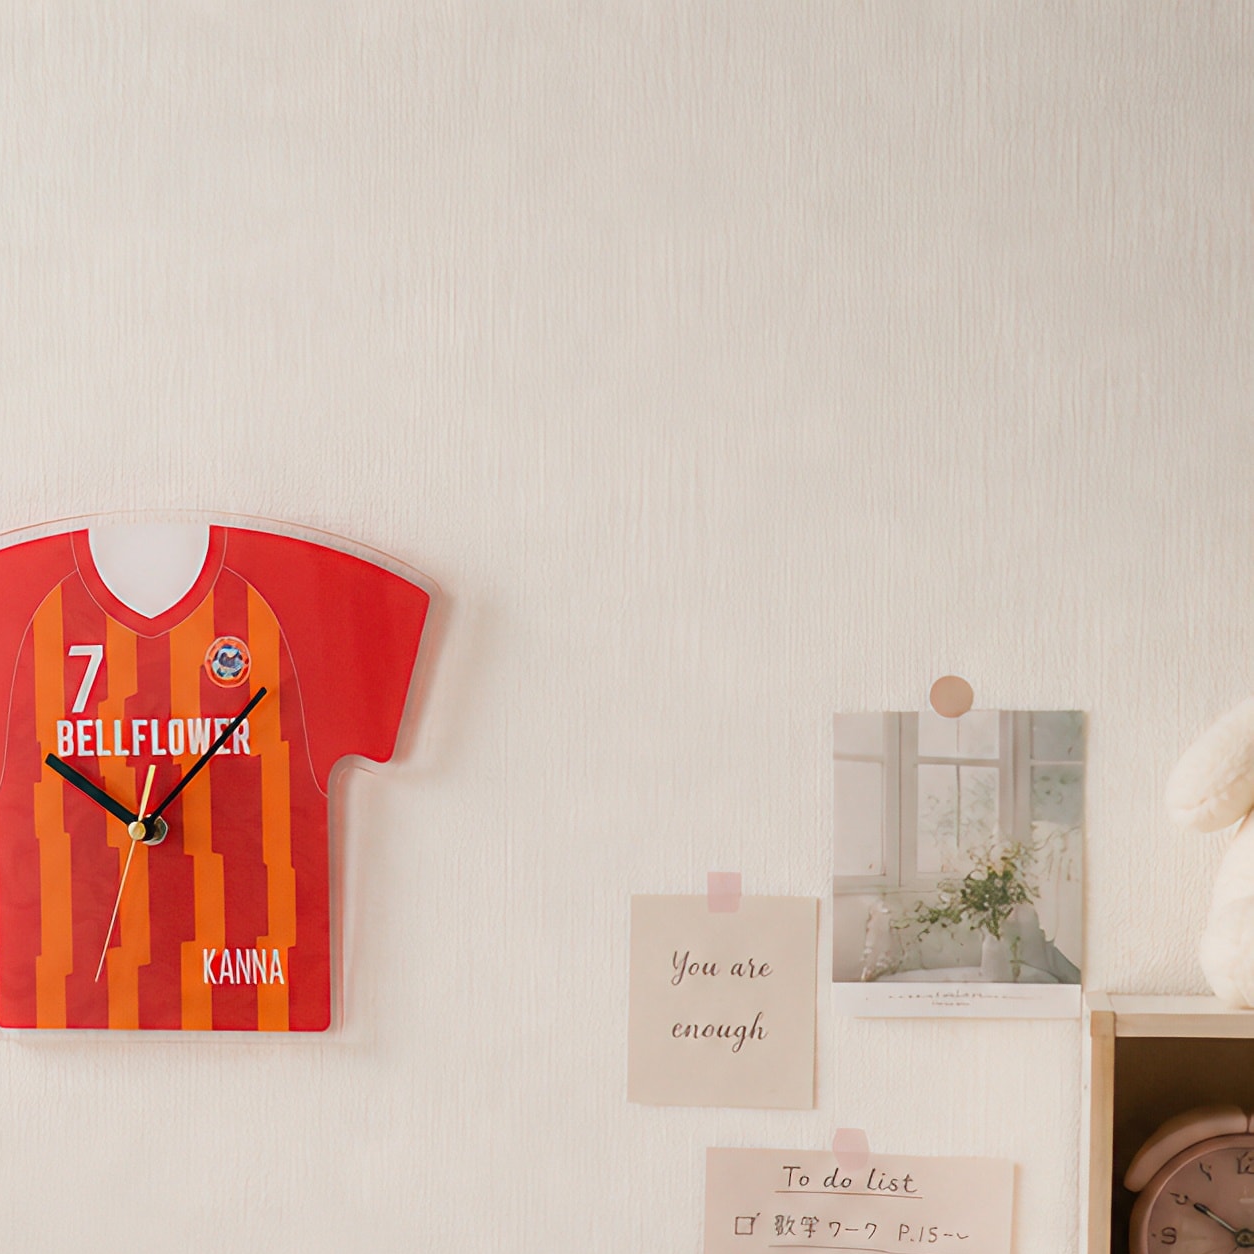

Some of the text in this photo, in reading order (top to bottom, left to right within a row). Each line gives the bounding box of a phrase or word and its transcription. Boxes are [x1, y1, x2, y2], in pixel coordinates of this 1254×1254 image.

[68, 645, 104, 713] 7
[56, 718, 251, 757] BELLFLOWER
[202, 948, 285, 985] KANNA
[671, 950, 774, 986] You are
[672, 1011, 770, 1053] enough
[782, 1165, 918, 1193] To do list
